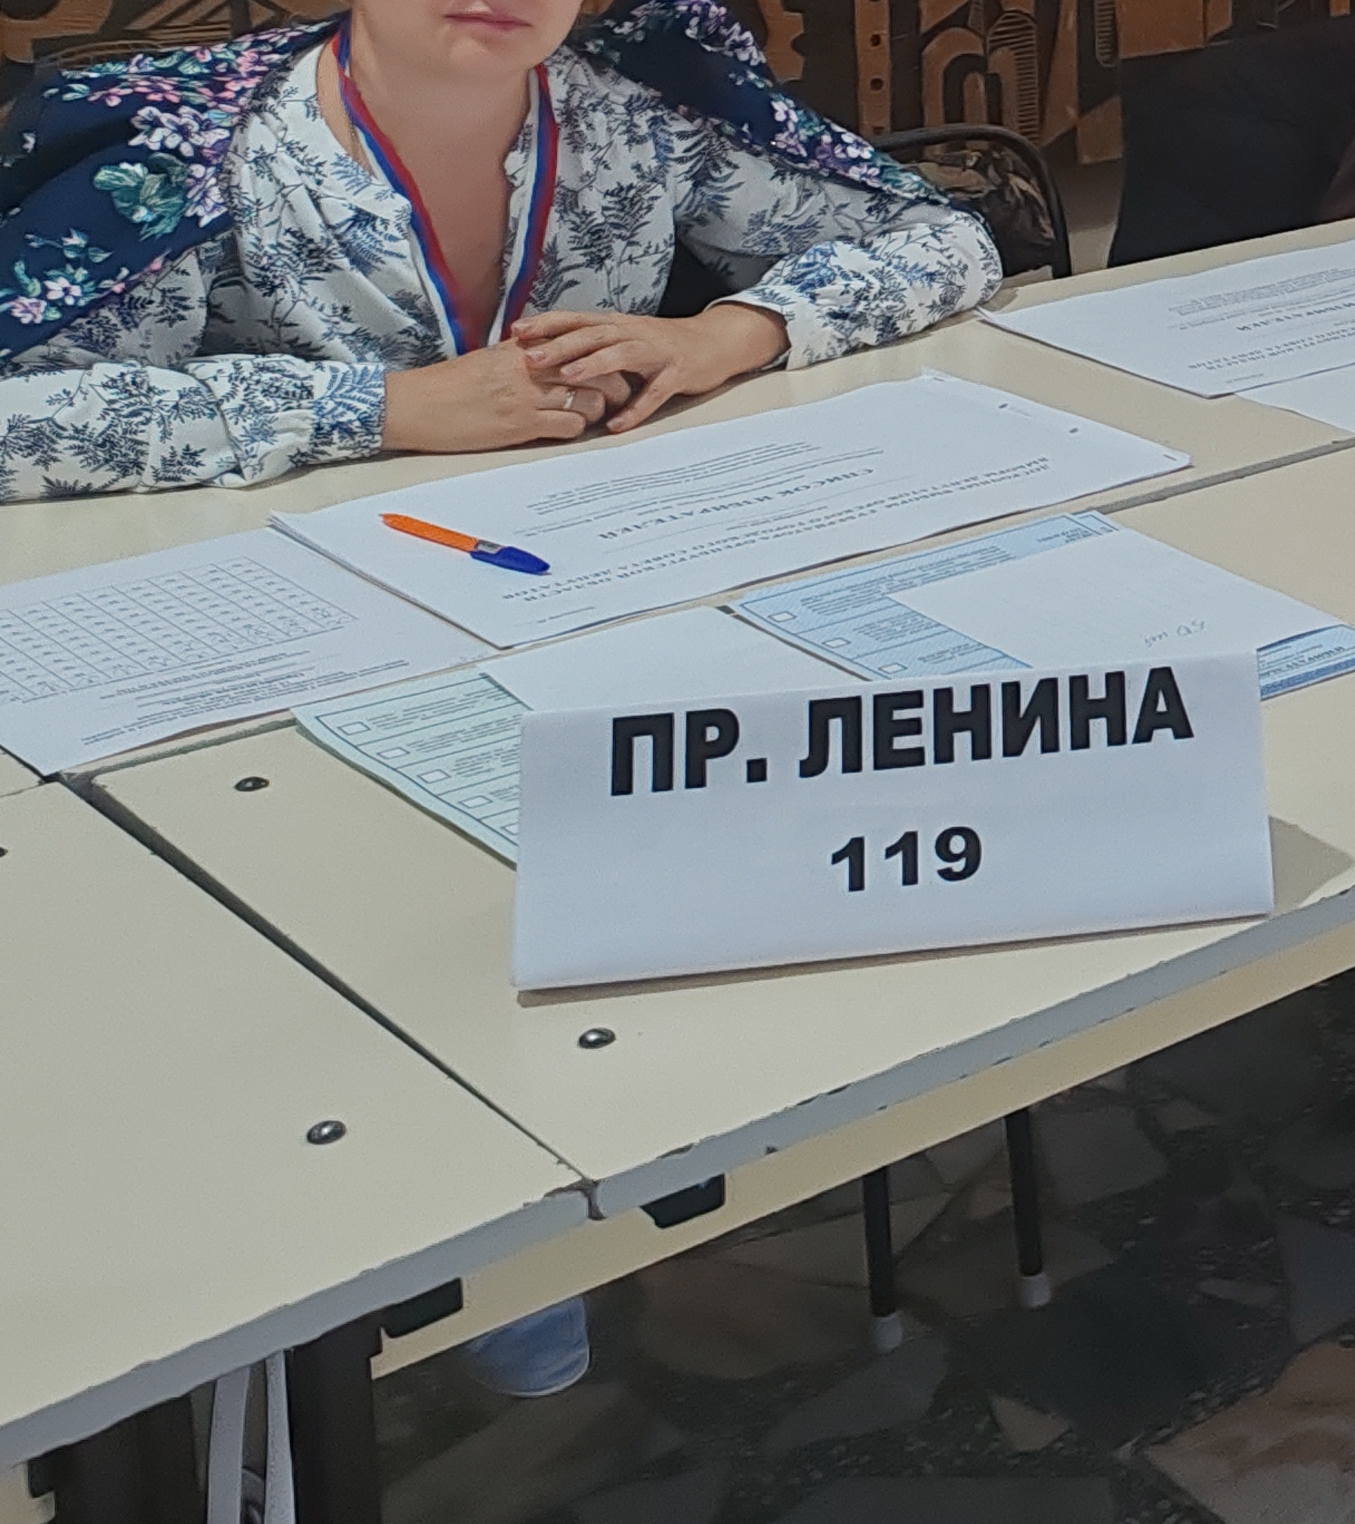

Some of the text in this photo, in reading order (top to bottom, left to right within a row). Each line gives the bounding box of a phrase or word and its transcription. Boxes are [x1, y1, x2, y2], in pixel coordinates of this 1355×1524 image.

[611, 709, 767, 796] ПР.
[799, 663, 1194, 778] ЛЕНИНА
[831, 827, 981, 892] 119
